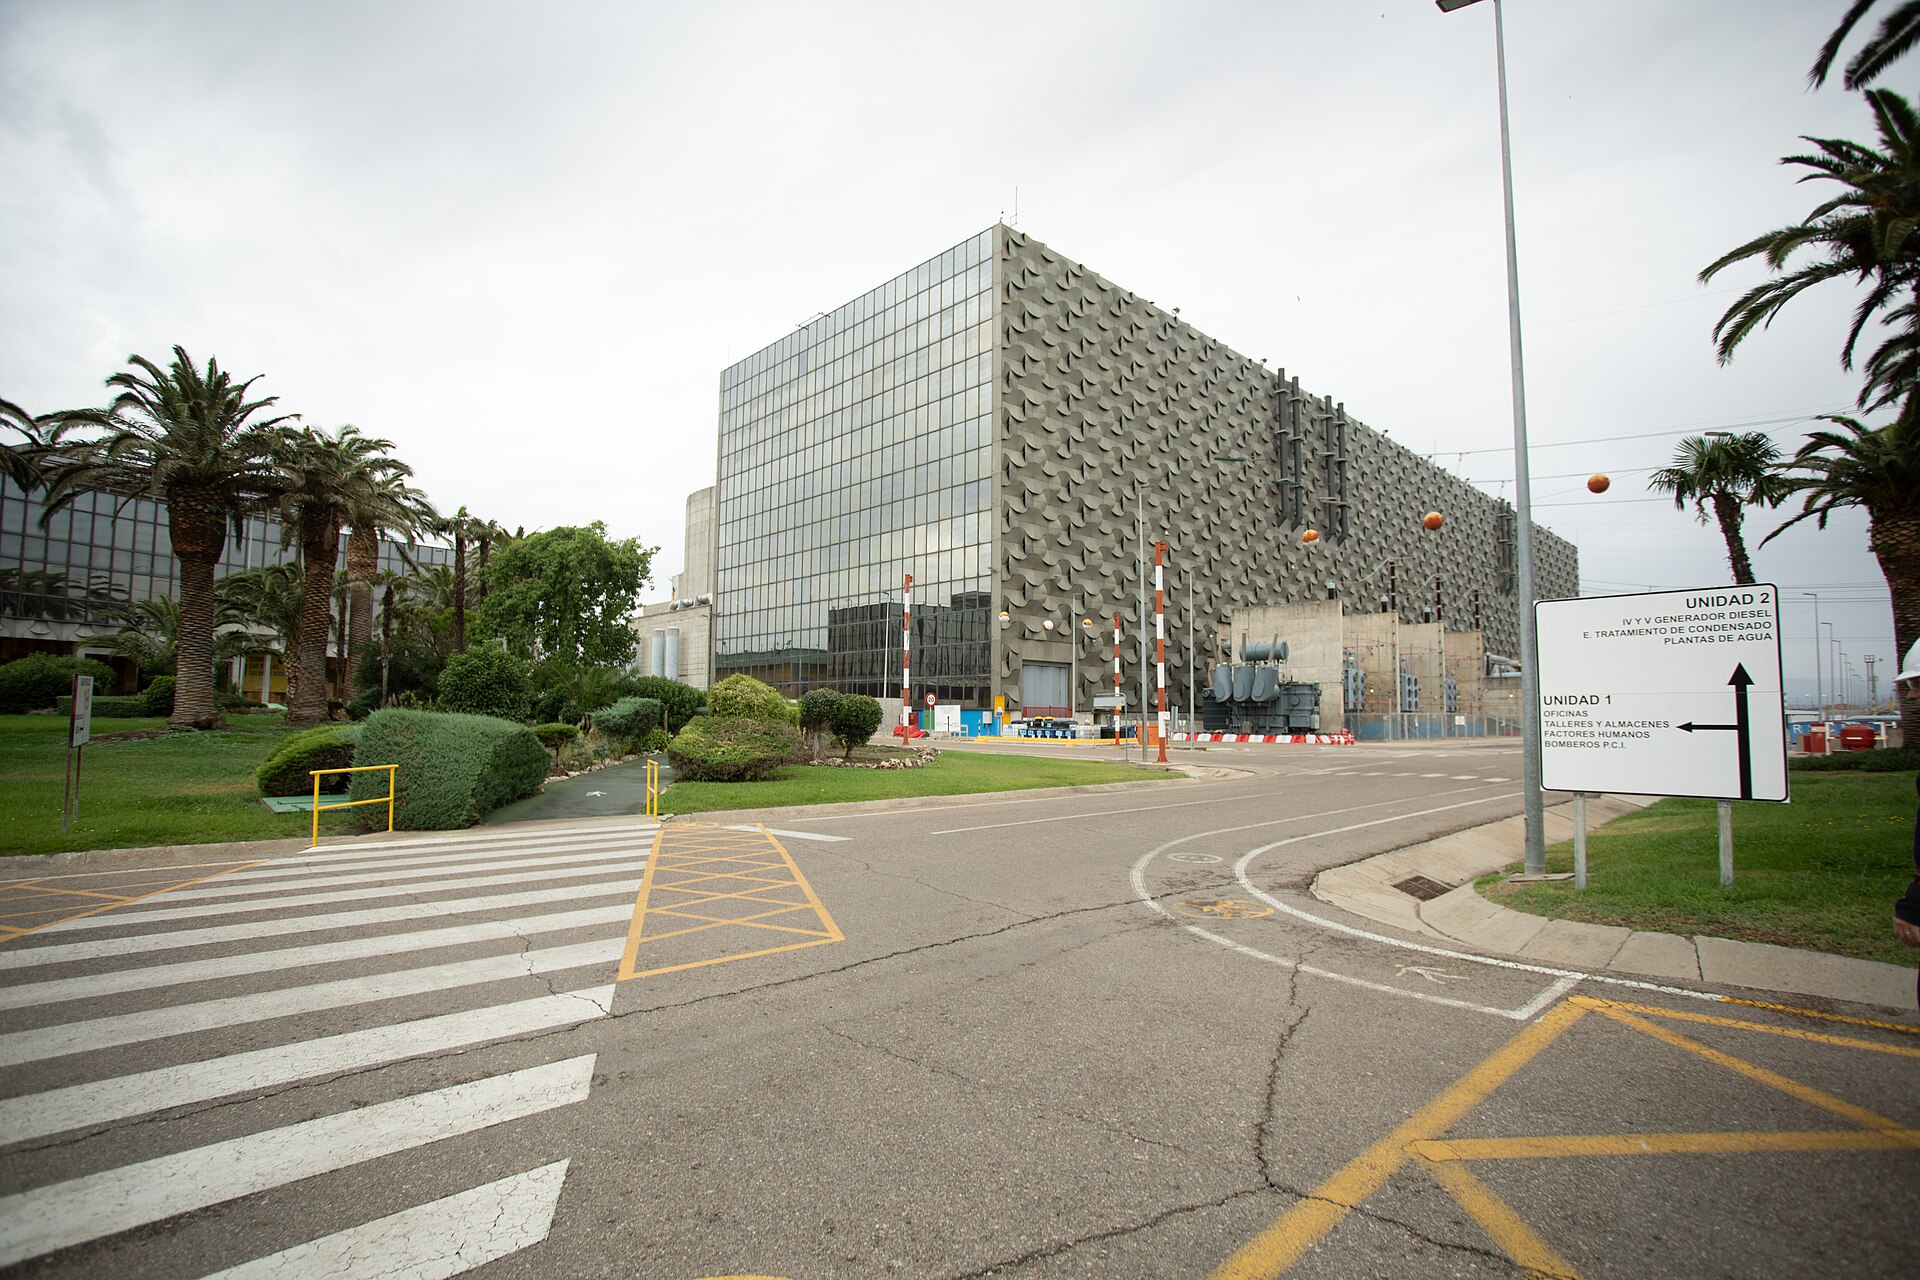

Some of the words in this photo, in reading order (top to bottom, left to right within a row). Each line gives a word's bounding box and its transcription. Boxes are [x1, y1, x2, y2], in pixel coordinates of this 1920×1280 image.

[1686, 594, 1754, 609] UNIDAD
[1760, 593, 1770, 604] 2
[1654, 612, 1726, 624] GENERADOR
[1729, 610, 1771, 619] DIESEL
[1595, 627, 1667, 638] TRATAMIENTO
[1671, 626, 1684, 634] DE
[1688, 621, 1771, 633] CONDENSADO
[1664, 635, 1714, 645] PLANTAS
[1718, 634, 1734, 642] DE
[1737, 633, 1772, 641] AGUA
[1543, 695, 1599, 705] UNIDAD
[1605, 695, 1611, 704] 1
